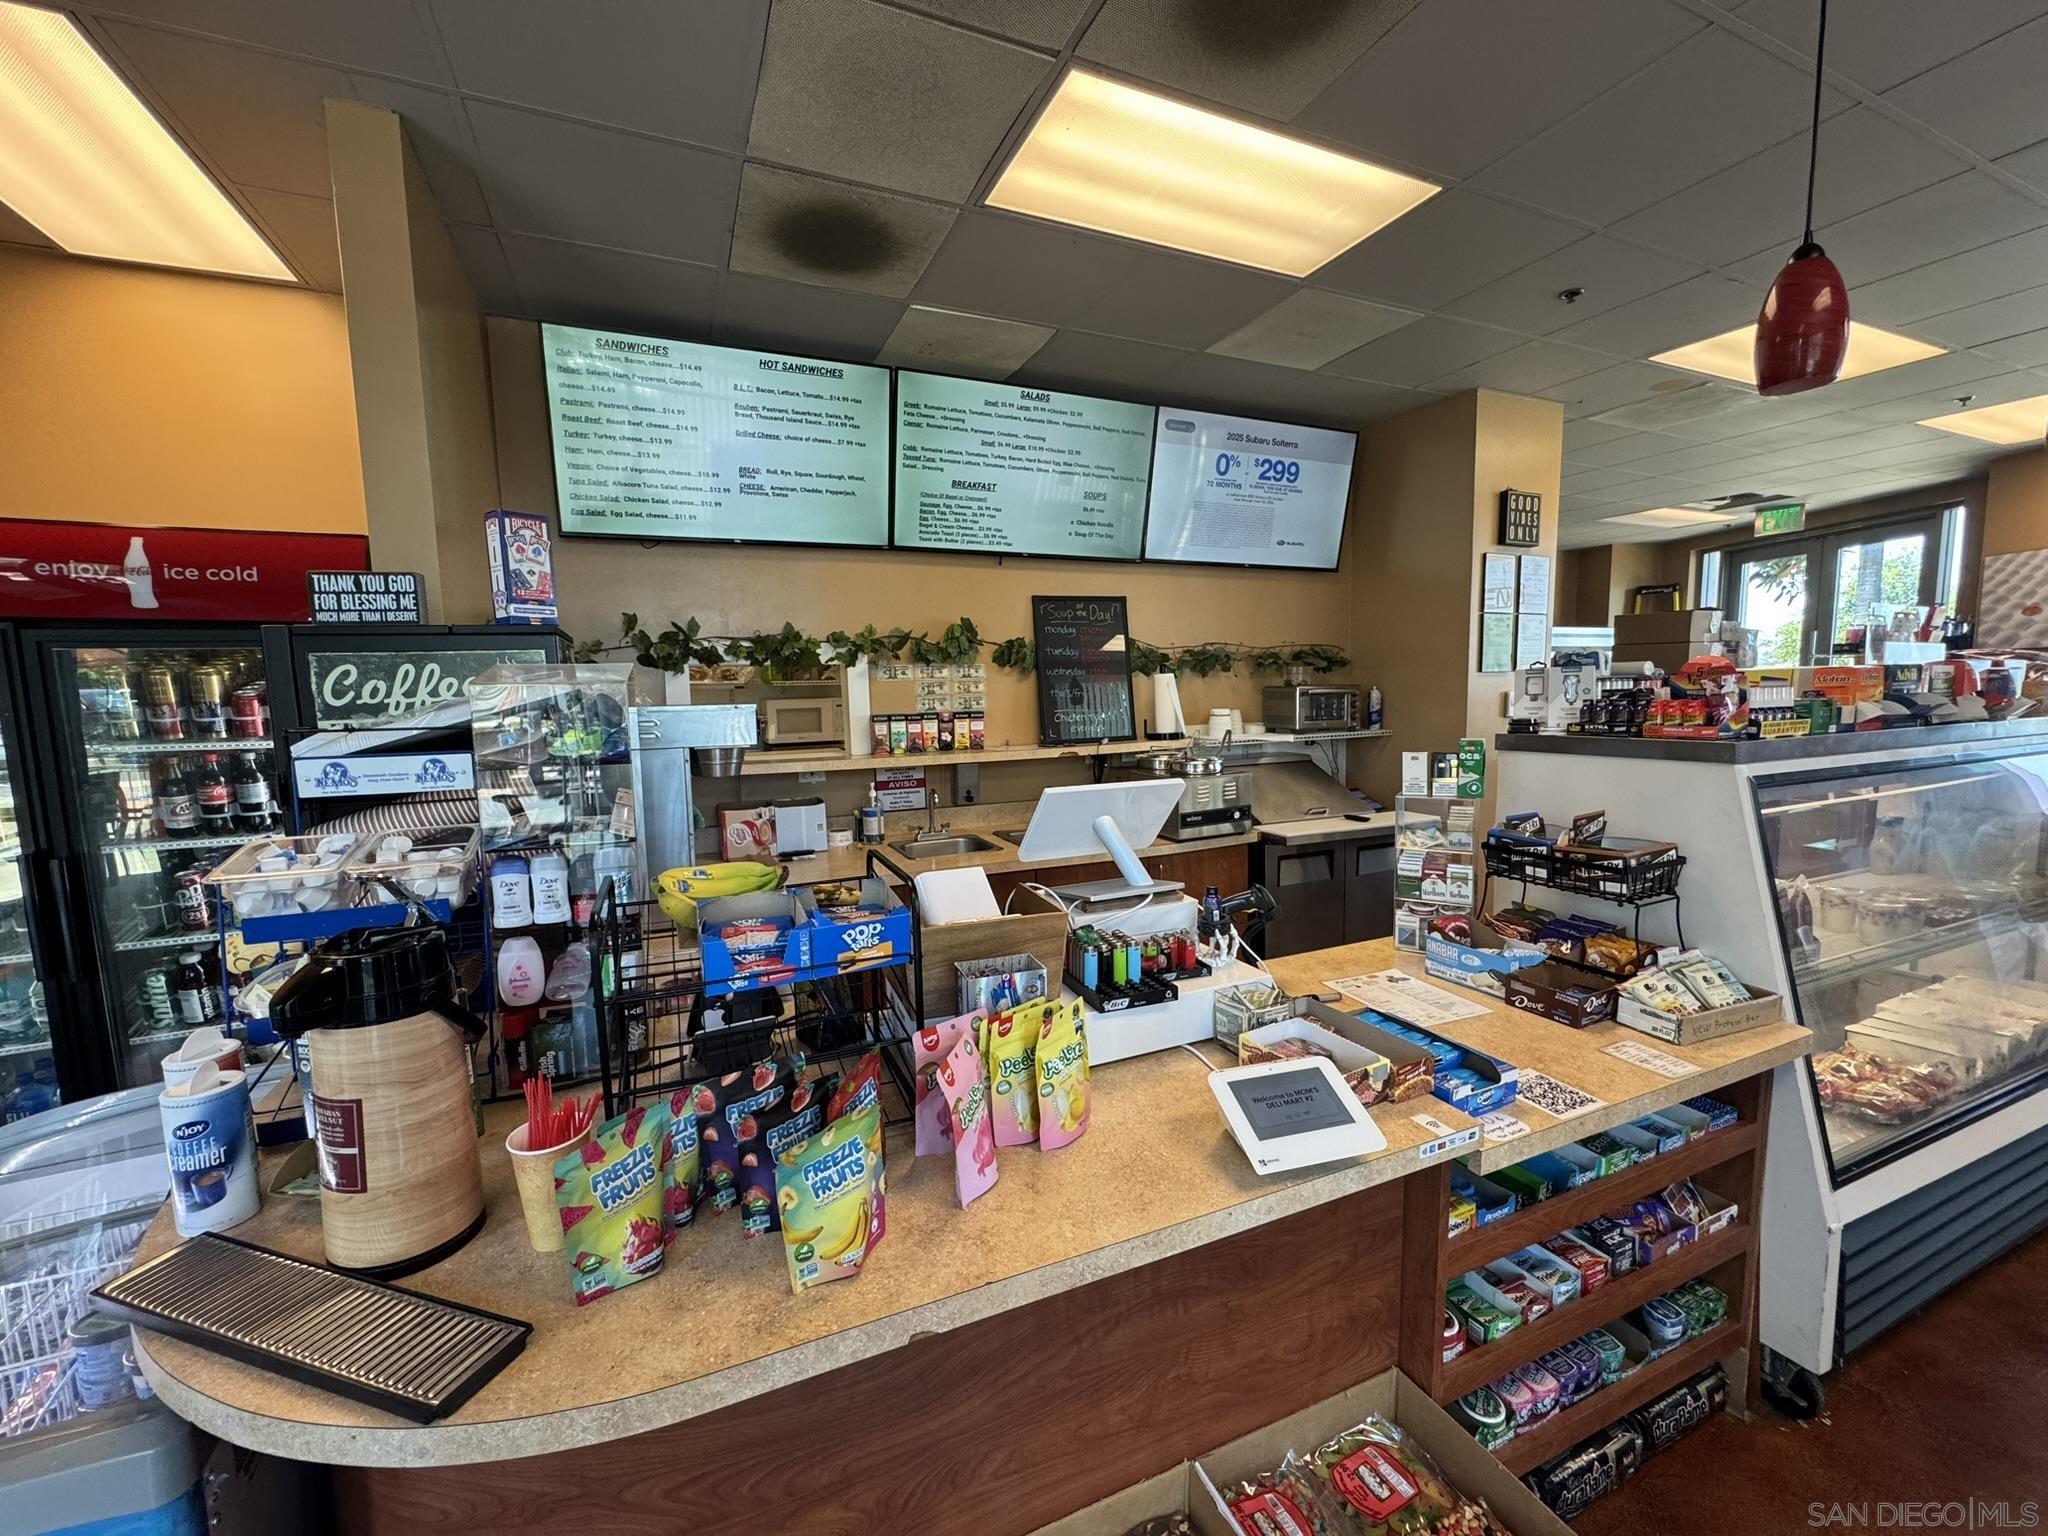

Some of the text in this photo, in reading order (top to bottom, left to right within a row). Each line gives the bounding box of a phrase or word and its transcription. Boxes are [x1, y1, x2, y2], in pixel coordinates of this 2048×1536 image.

[595, 337, 669, 356] SANDWICHES
[760, 359, 844, 379] HOT SANDWICHES
[756, 386, 776, 396] Bacon,
[1020, 391, 1050, 403] SALADS
[562, 413, 582, 423] Roast
[606, 417, 626, 425] Roast
[756, 413, 803, 424] Thousand Island
[1226, 432, 1298, 449] 2025 Subaru Solterra
[1216, 453, 1240, 476] 0%
[1254, 458, 1300, 484] $299
[770, 485, 798, 493] American,
[800, 487, 824, 495] Cheddar,
[951, 480, 997, 492] BREAKFAST
[1215, 480, 1242, 490] MONTHS
[624, 496, 650, 504] Chicken
[1510, 494, 1539, 512] GOOD
[610, 510, 623, 518] Egg
[1510, 510, 1538, 526] VIBES
[1509, 525, 1538, 542] ONLY
[35, 560, 109, 580] enjoy
[163, 563, 200, 580] ice
[206, 566, 259, 582] cold
[312, 575, 415, 592] THANK YOU GOD
[314, 594, 417, 610] FOR BLESSING ME
[316, 612, 417, 621] MUCH MORE THAN I DESERVE
[1048, 605, 1073, 619] Soup
[1044, 625, 1076, 636] monday
[1046, 647, 1079, 658] tuesday
[1896, 668, 1916, 680] Advil
[500, 880, 520, 888] Dove
[851, 936, 880, 951] tarts
[1714, 1019, 1741, 1030] Protein
[1251, 1094, 1285, 1104] Welcome
[1284, 1097, 1304, 1105] MART
[171, 1137, 216, 1155] COFFEE
[809, 1157, 866, 1201] FRUITS
[598, 1161, 656, 1212] FRUITS
[1606, 1235, 1624, 1246] ICE
[1653, 1399, 1708, 1444] duraflame
[1556, 1463, 1615, 1515] duraflame
